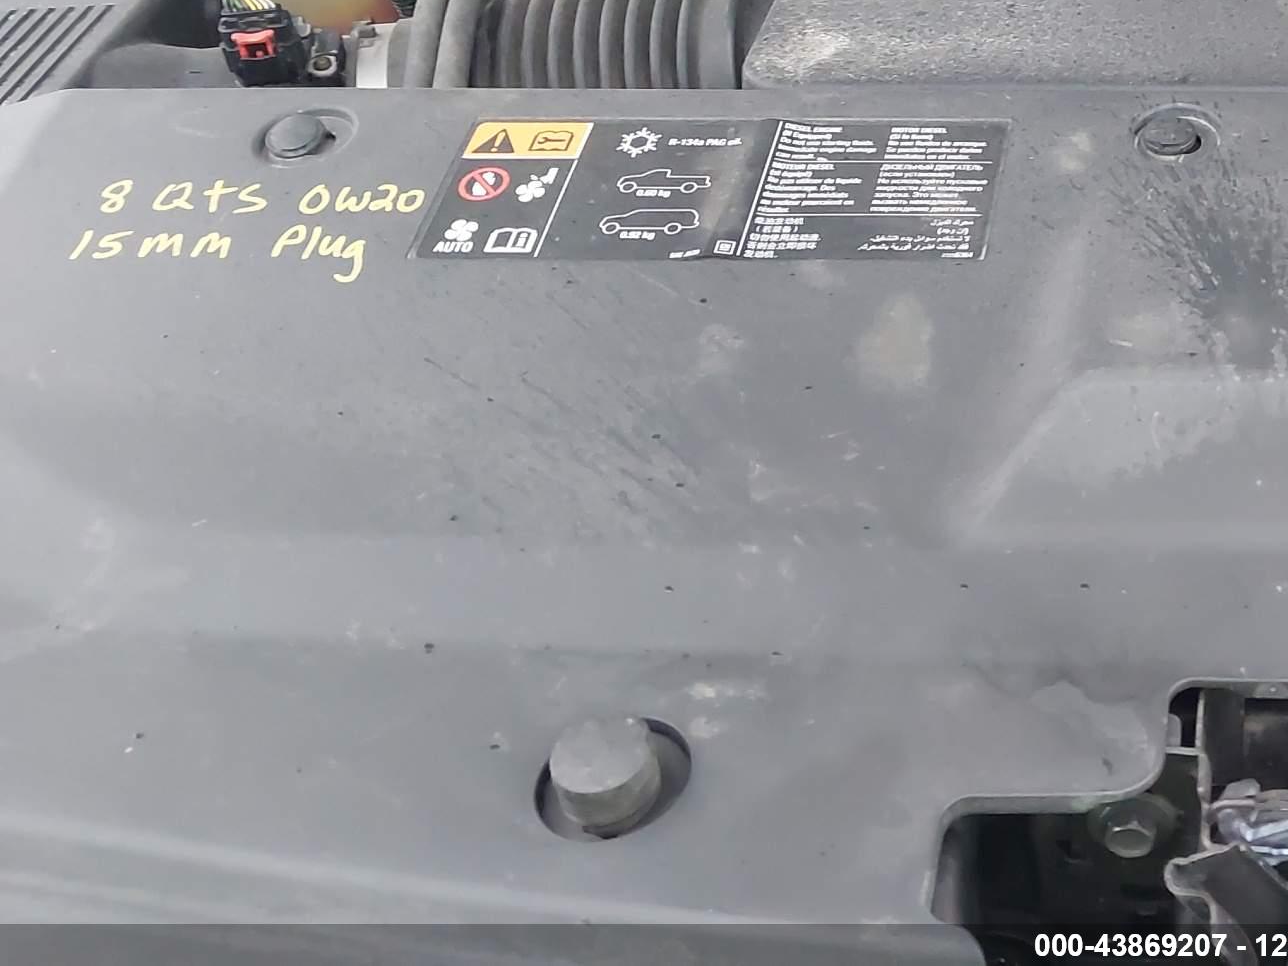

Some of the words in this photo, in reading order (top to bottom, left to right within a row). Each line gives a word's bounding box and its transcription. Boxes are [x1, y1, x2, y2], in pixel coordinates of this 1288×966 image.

[100, 179, 134, 214] 8
[271, 224, 366, 283] Plug
[432, 241, 474, 253] AUTO
